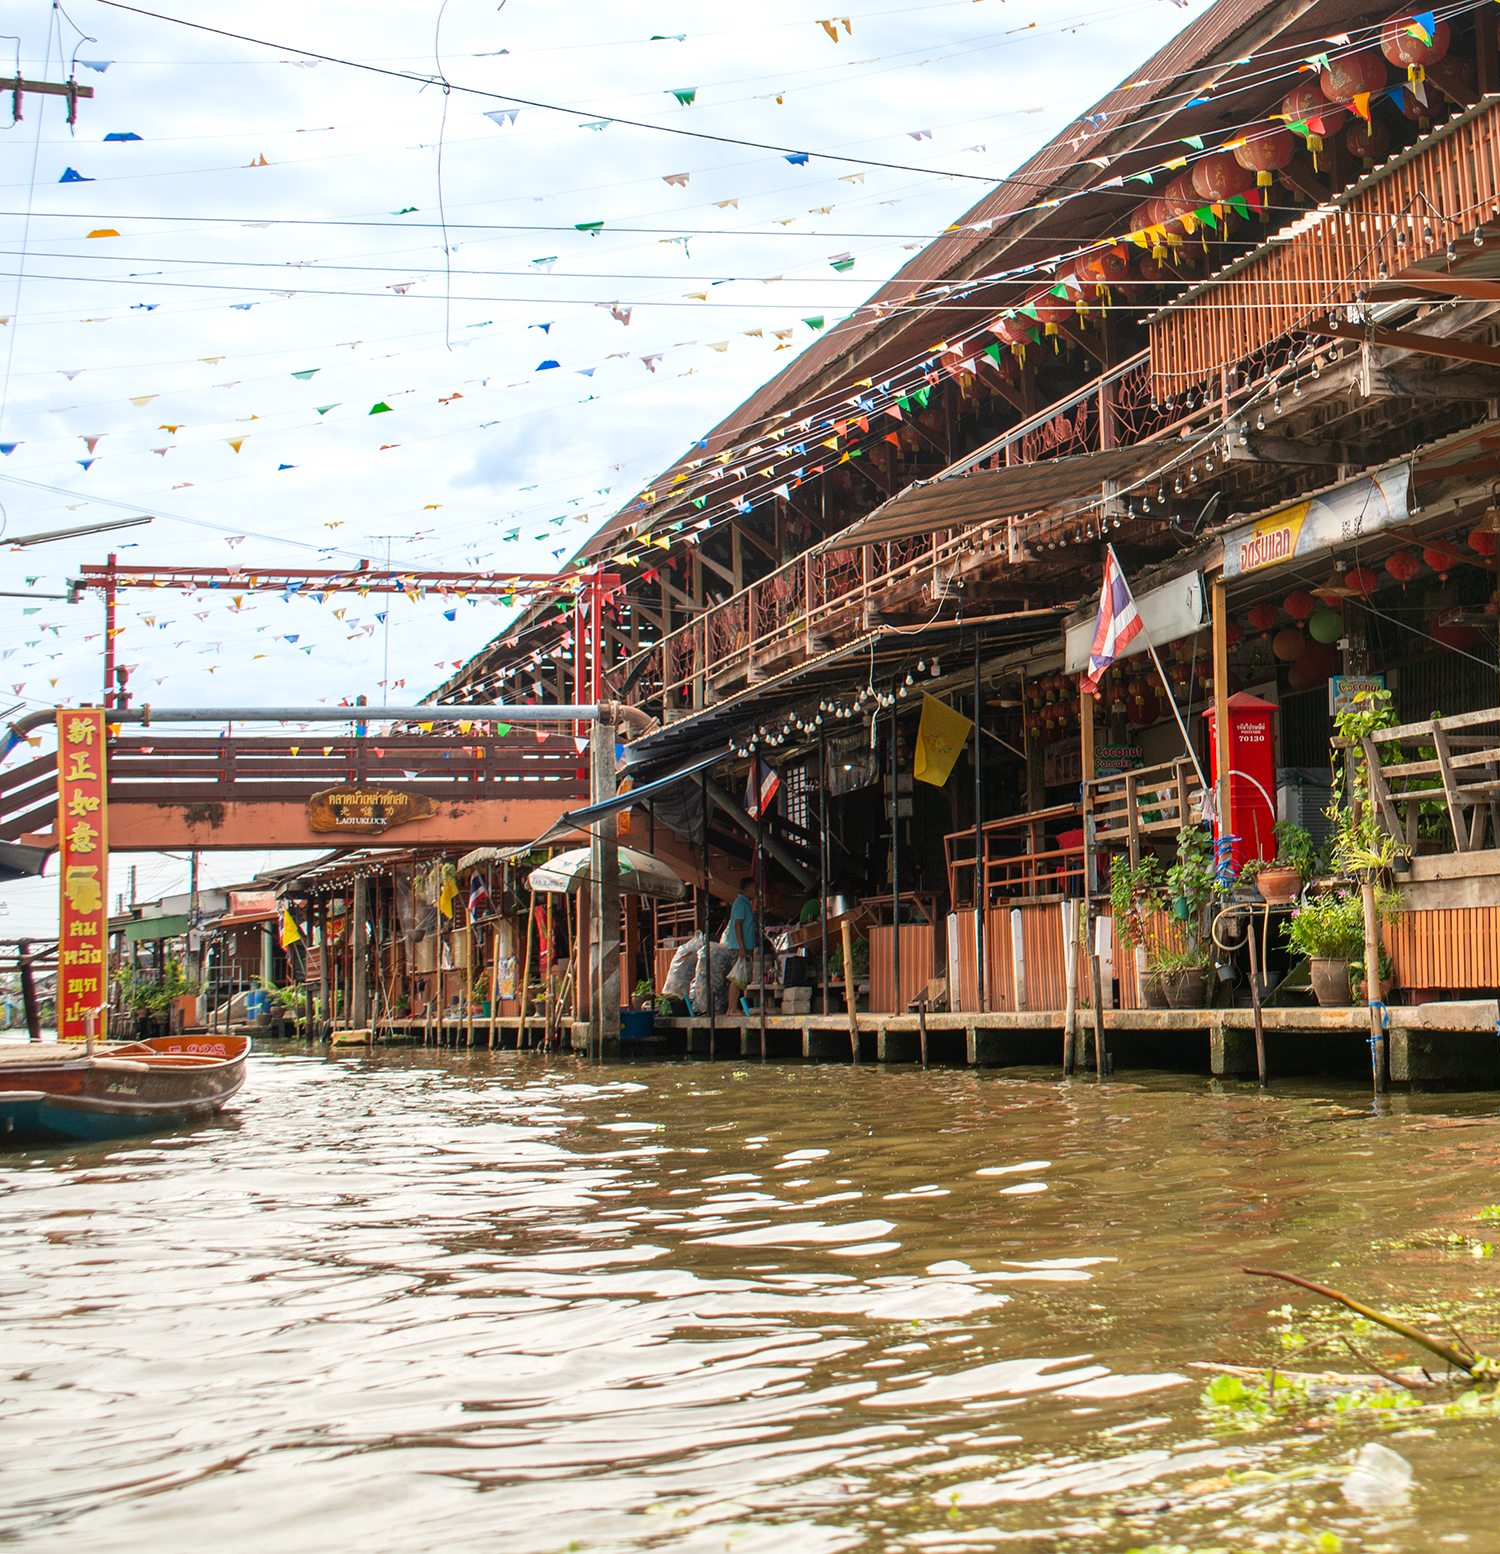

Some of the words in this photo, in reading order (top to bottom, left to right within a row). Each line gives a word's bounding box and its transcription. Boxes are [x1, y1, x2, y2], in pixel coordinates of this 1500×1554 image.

[1338, 681, 1382, 694] Coconut
[1095, 745, 1142, 758] Coconut
[1095, 758, 1132, 768] Pancake
[65, 717, 100, 853] 新正如意
[335, 817, 388, 825] LAOTUKLUCK
[63, 942, 102, 965] หวัง
[68, 977, 98, 1000] ทุก
